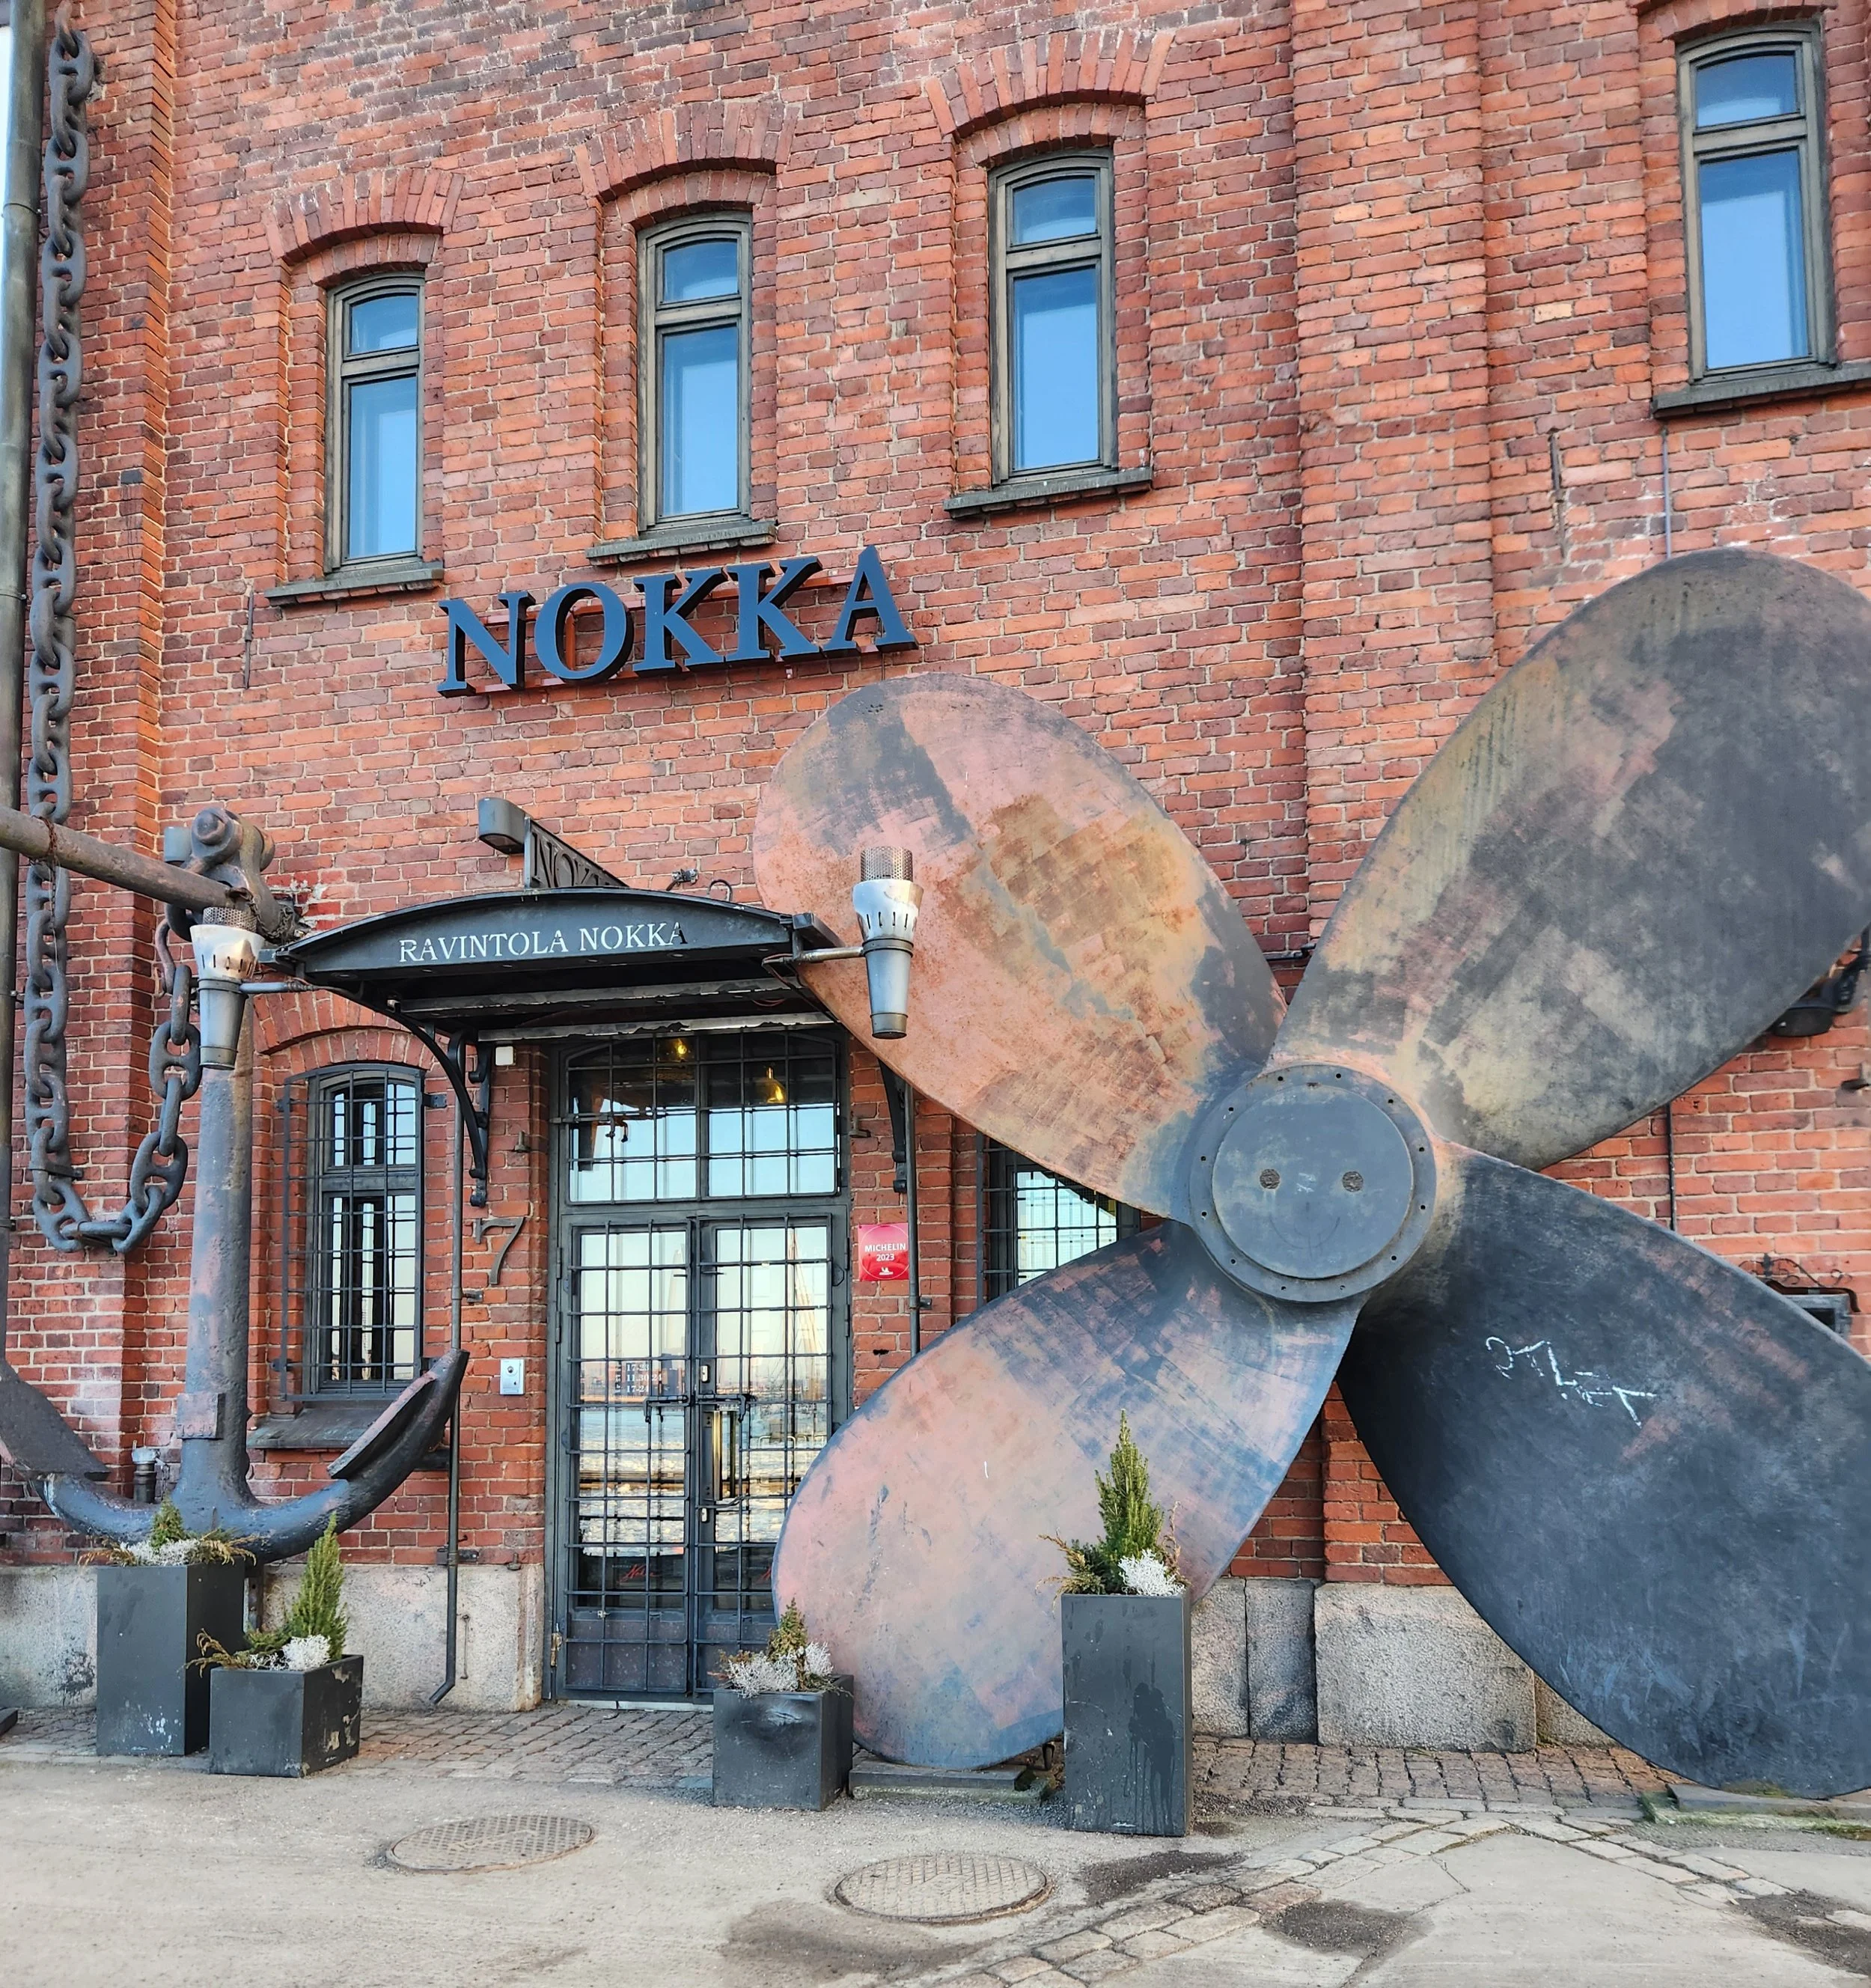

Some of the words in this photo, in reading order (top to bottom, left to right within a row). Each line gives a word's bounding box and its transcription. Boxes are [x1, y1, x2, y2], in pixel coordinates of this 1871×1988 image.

[437, 544, 918, 698] NOKKA
[399, 930, 569, 963] RAVINTOLA
[579, 921, 689, 951] NOKKA
[475, 1218, 524, 1285] 7
[864, 1242, 906, 1252] MICHELIN
[876, 1253, 895, 1262] 2023
